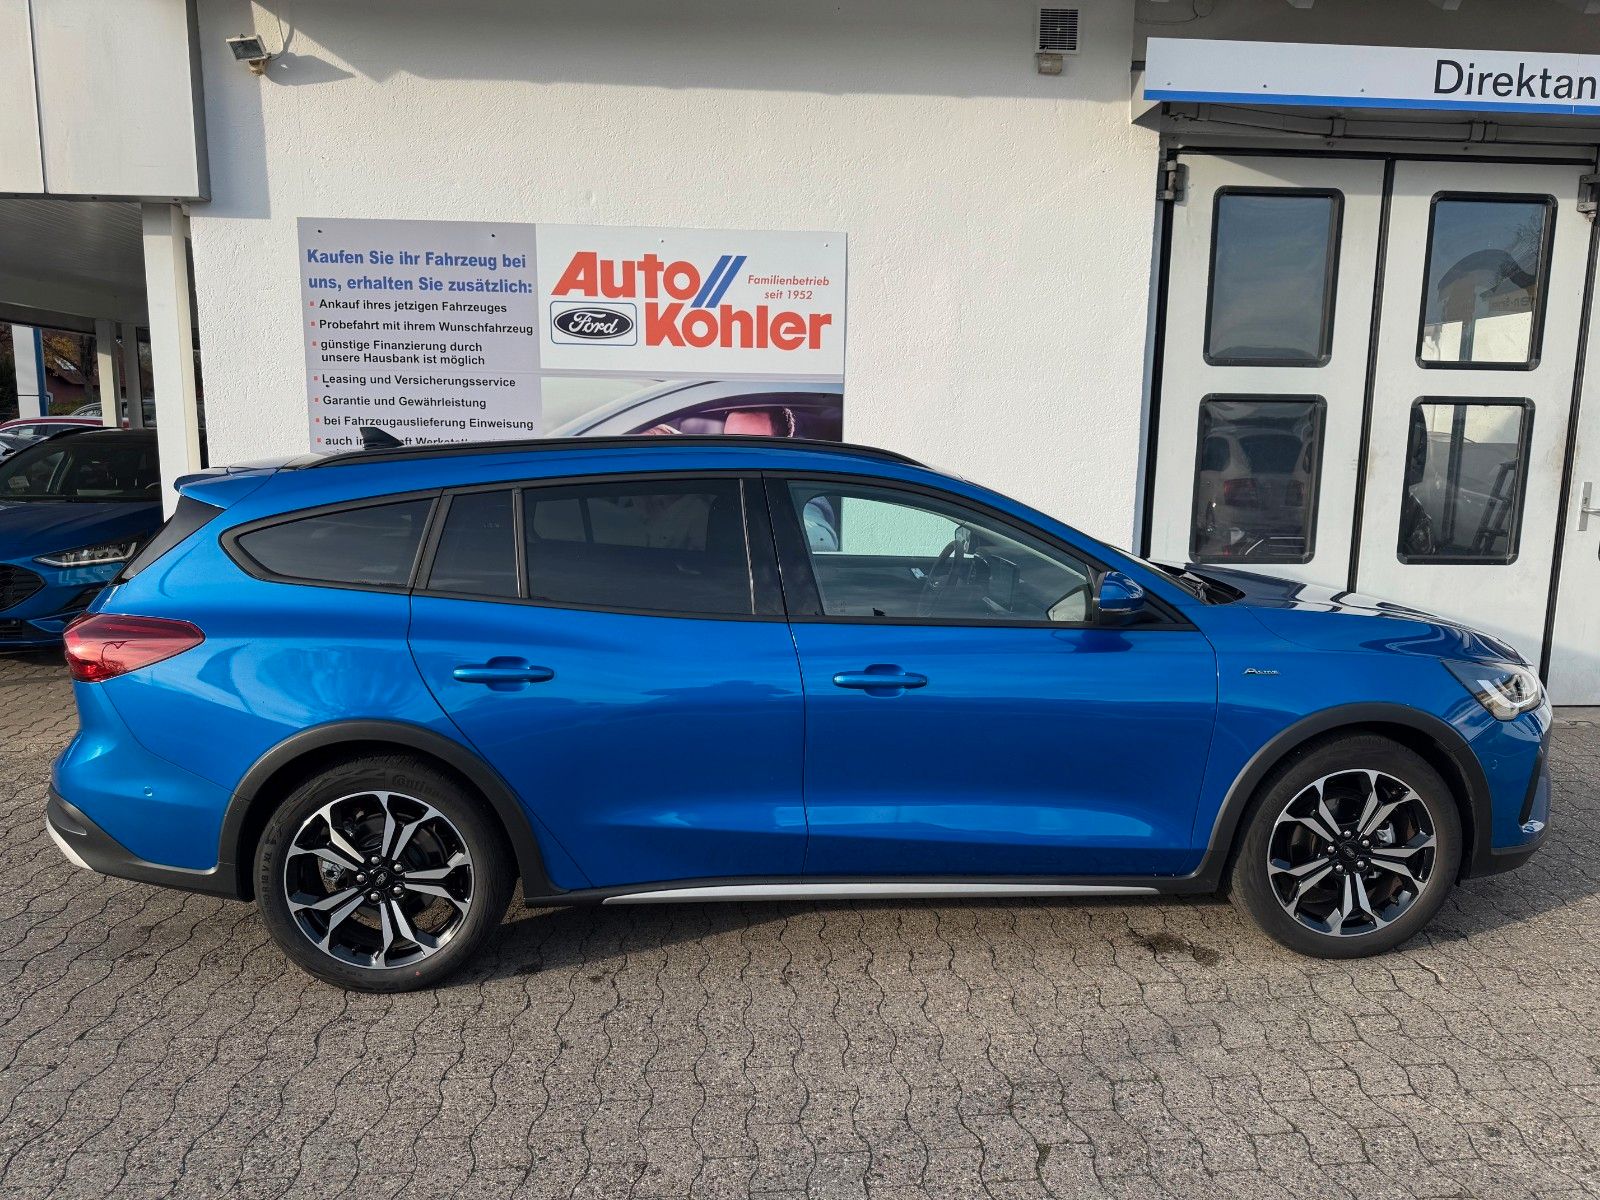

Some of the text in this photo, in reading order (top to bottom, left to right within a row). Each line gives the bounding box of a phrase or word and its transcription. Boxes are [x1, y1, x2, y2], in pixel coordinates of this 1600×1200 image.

[1434, 59, 1597, 100] Direktan
[307, 249, 526, 270] Kaufen Sie ihr Fahrzeug bei
[551, 251, 701, 300] Auto
[748, 274, 830, 287] Familienbetrieb
[308, 276, 533, 293] uns, erhalten Sie zusätzlich:
[764, 289, 813, 300] seit 1952
[319, 299, 507, 313] Ankauf ihres jetzigen Fahrzeuges
[319, 320, 533, 335] Probefahrt mit ihrem Wunschfahrzeug
[568, 311, 619, 335] Ford
[320, 339, 482, 352] günstige Finanzierung durch
[321, 353, 485, 367] unsere Hausbank ist möglich
[322, 374, 516, 387] Leasing und Versicherungsservice
[323, 395, 486, 409] Garantie und Gewährleistung
[324, 416, 533, 431] bei Fahrzeugauslieferung Einweisung
[325, 436, 353, 446] auch
